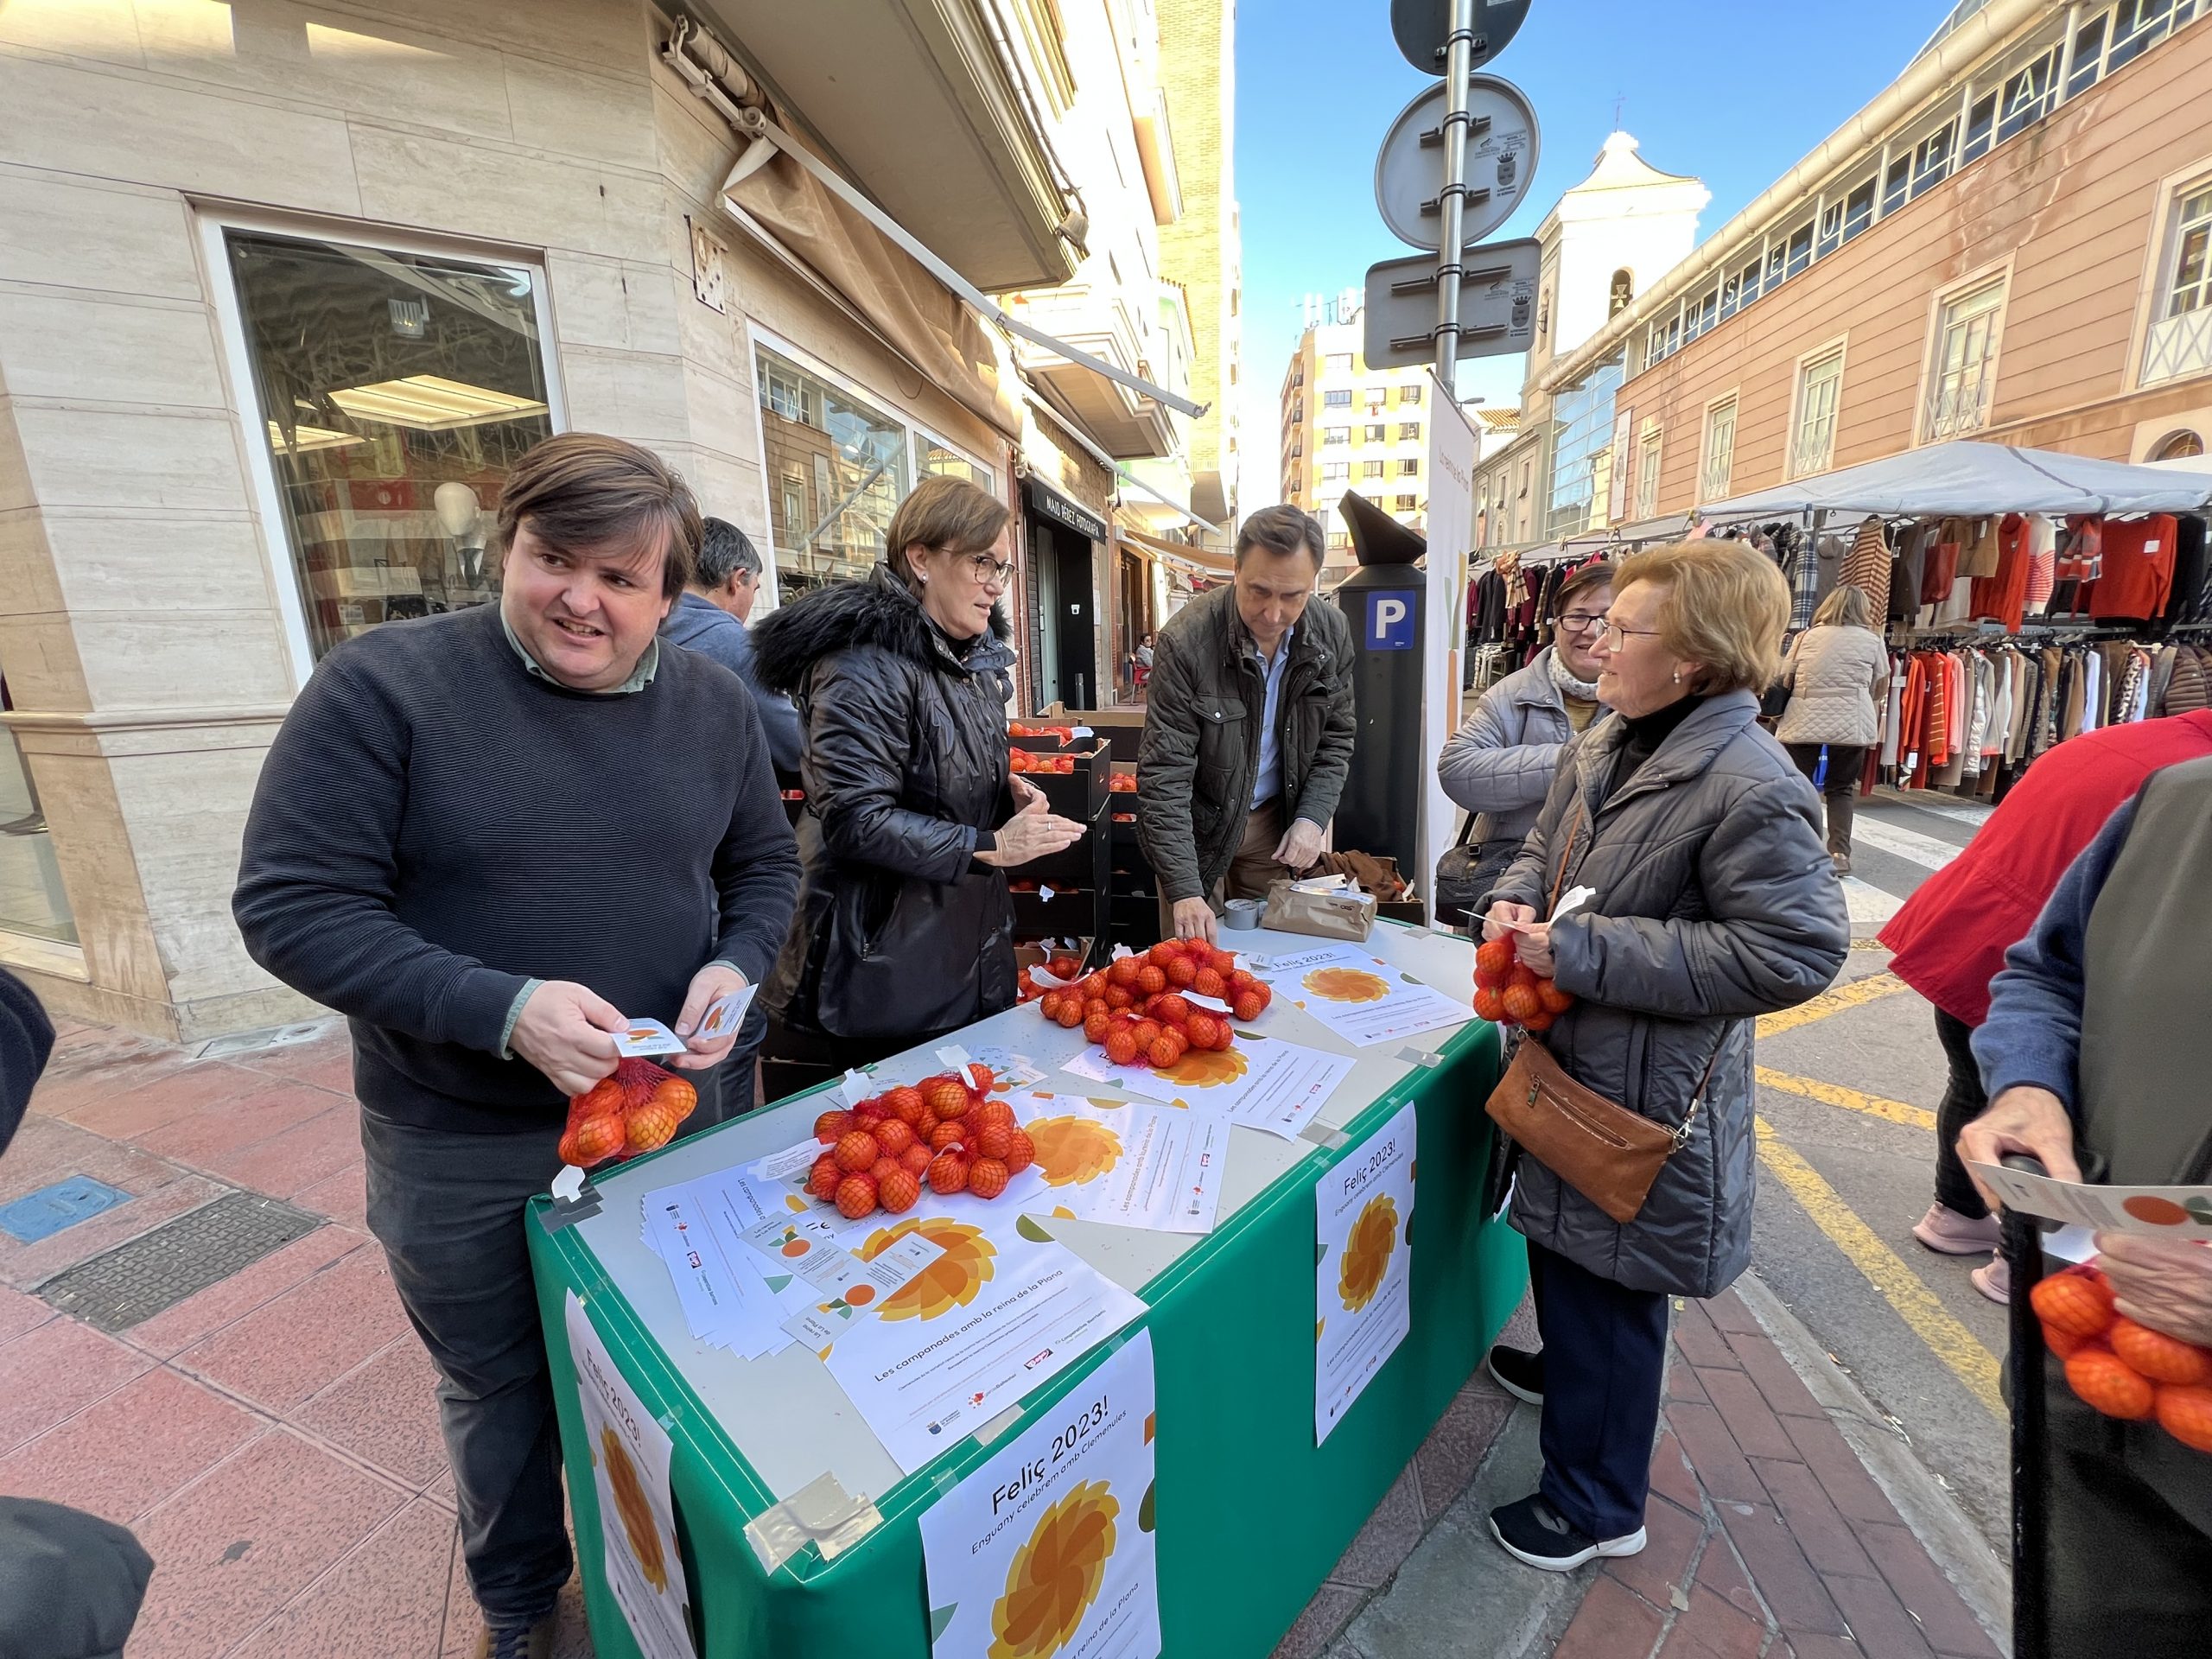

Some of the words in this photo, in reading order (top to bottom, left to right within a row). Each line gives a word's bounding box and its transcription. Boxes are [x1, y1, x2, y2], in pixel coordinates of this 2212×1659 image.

[1046, 495, 1060, 517] MAJO
[1061, 503, 1076, 525] PÉREZ
[1376, 599, 1407, 639] P
[1302, 952, 1336, 963] 2023!
[1344, 1167, 1367, 1196] Feliç
[1370, 1138, 1395, 1173] 2023!
[874, 1368, 895, 1383] Les
[896, 1330, 961, 1370] campanades
[960, 1317, 982, 1332] amb
[982, 1310, 993, 1319] la
[993, 1296, 1017, 1313] reina
[1017, 1289, 1029, 1299] de
[1027, 1283, 1039, 1292] la
[1037, 1270, 1064, 1287] Plana
[610, 1386, 641, 1448] 2023!
[971, 1513, 1014, 1554] Enguany
[1016, 1471, 1059, 1514] celebrem
[1060, 1452, 1081, 1474] amb
[1081, 1410, 1127, 1455] Clemenules
[992, 1457, 1046, 1515] Feliç
[1052, 1395, 1109, 1463] 2023!
[1077, 1630, 1097, 1656] reina
[1099, 1618, 1109, 1631] de
[1109, 1605, 1117, 1618] la
[1117, 1582, 1140, 1606] Plana
